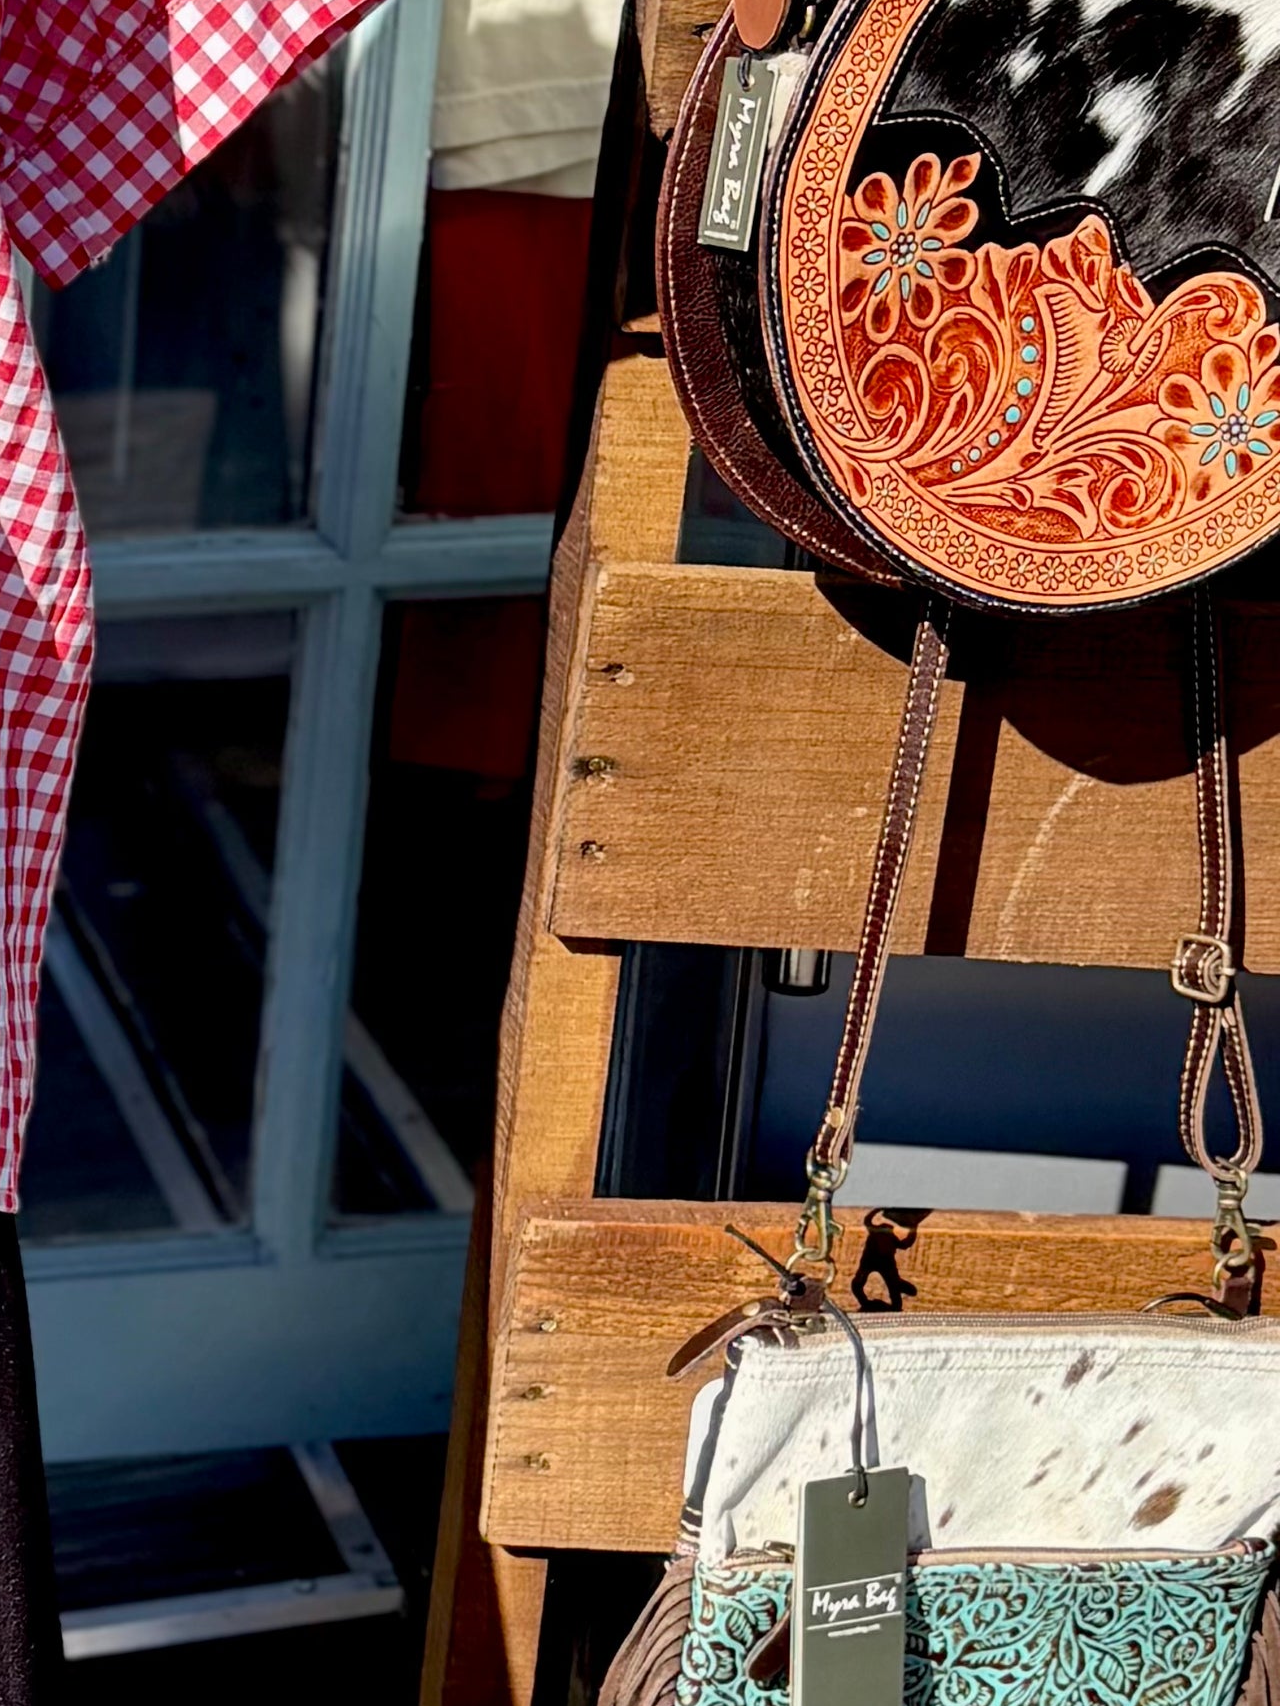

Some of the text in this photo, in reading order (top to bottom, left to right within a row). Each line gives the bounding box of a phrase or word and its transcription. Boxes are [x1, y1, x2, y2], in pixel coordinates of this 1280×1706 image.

[728, 97, 756, 170] Myra
[712, 177, 742, 226] Bag
[811, 1581, 897, 1623] Myra Bag
